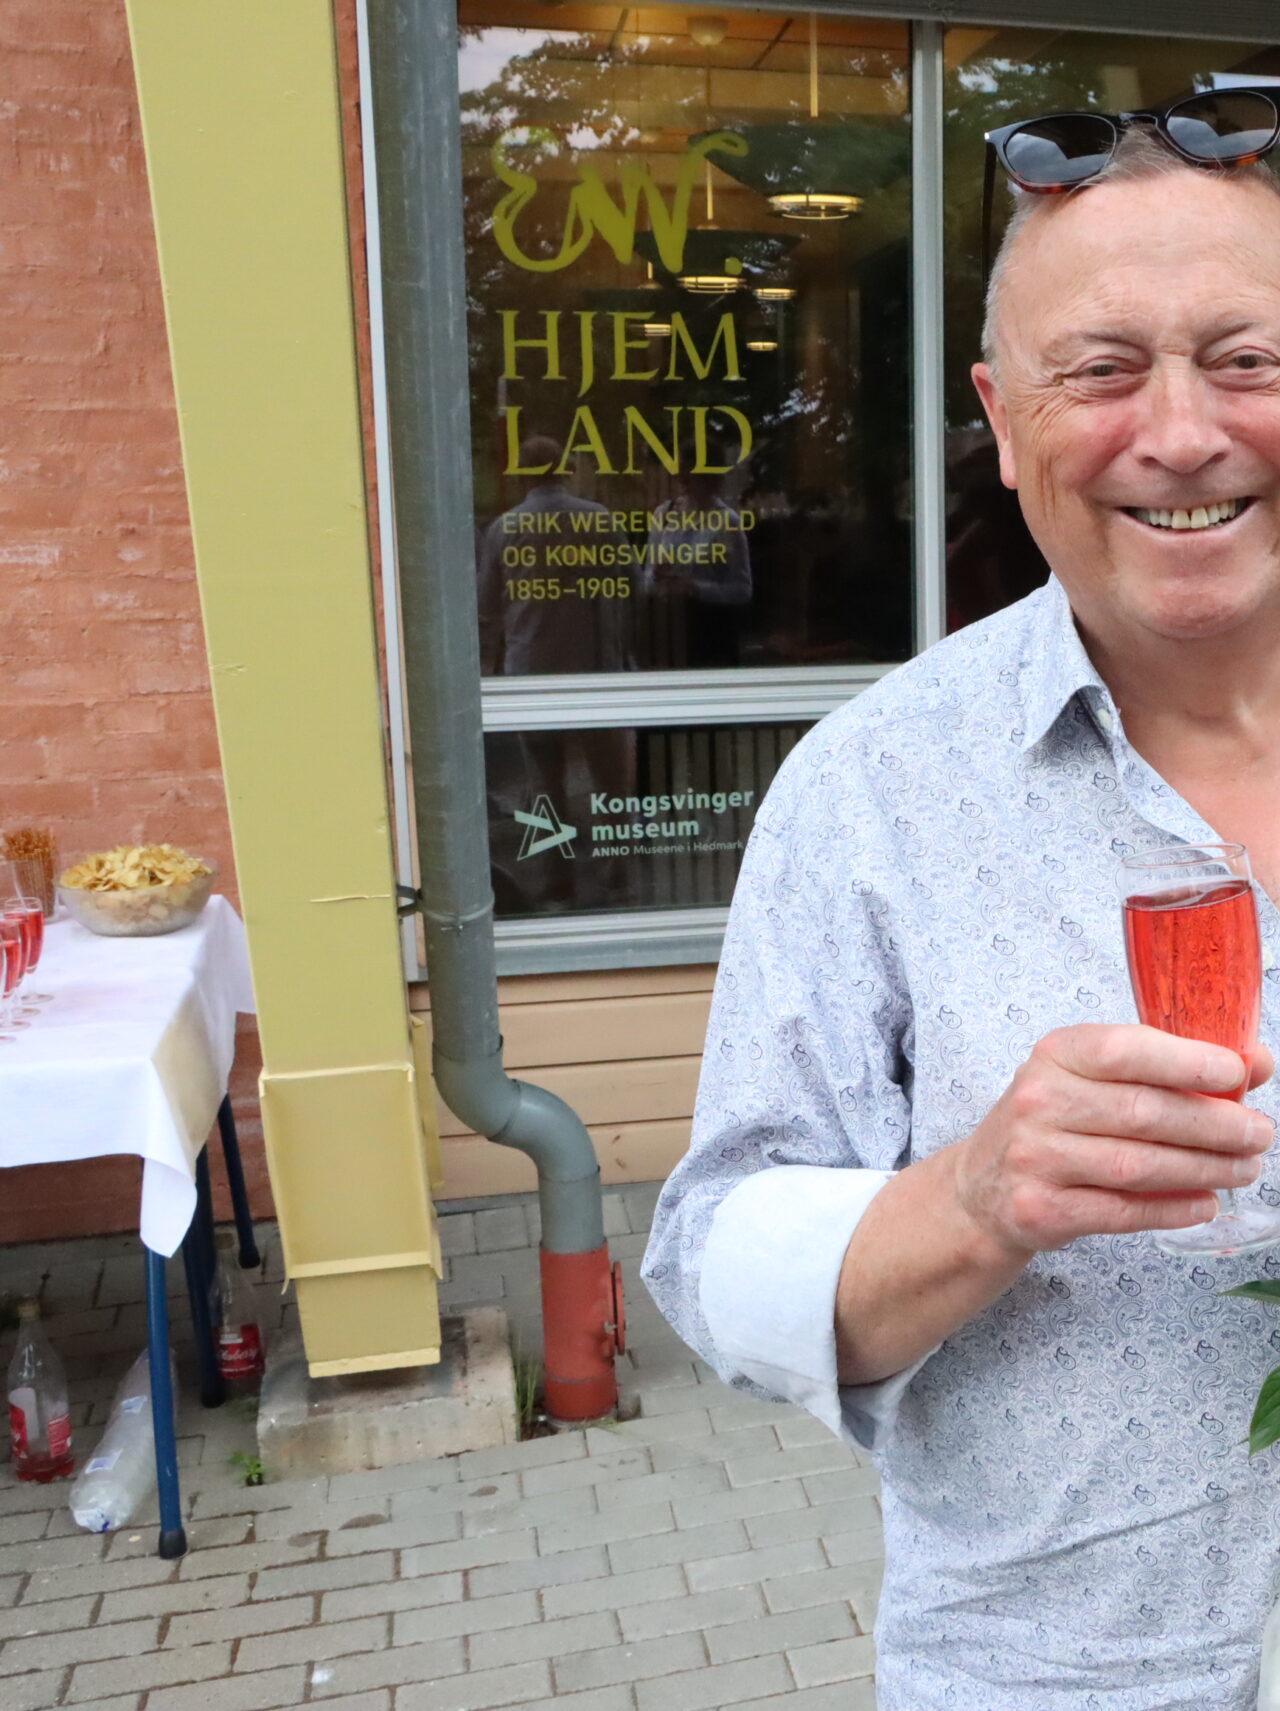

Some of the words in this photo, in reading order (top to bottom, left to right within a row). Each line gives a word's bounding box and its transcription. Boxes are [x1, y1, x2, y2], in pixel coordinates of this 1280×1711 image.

[497, 310, 746, 397] HJEM
[502, 405, 753, 476] LAND
[502, 512, 562, 534] ERIK
[570, 510, 756, 533] WERENSKIOLD
[503, 546, 537, 567] OG
[546, 543, 728, 566] KONGSVINGER
[590, 788, 754, 817] Kongsvinger
[592, 820, 700, 841] museum
[592, 846, 630, 858] ANNO
[633, 843, 685, 855] Museene
[693, 840, 744, 851] Hedmark
